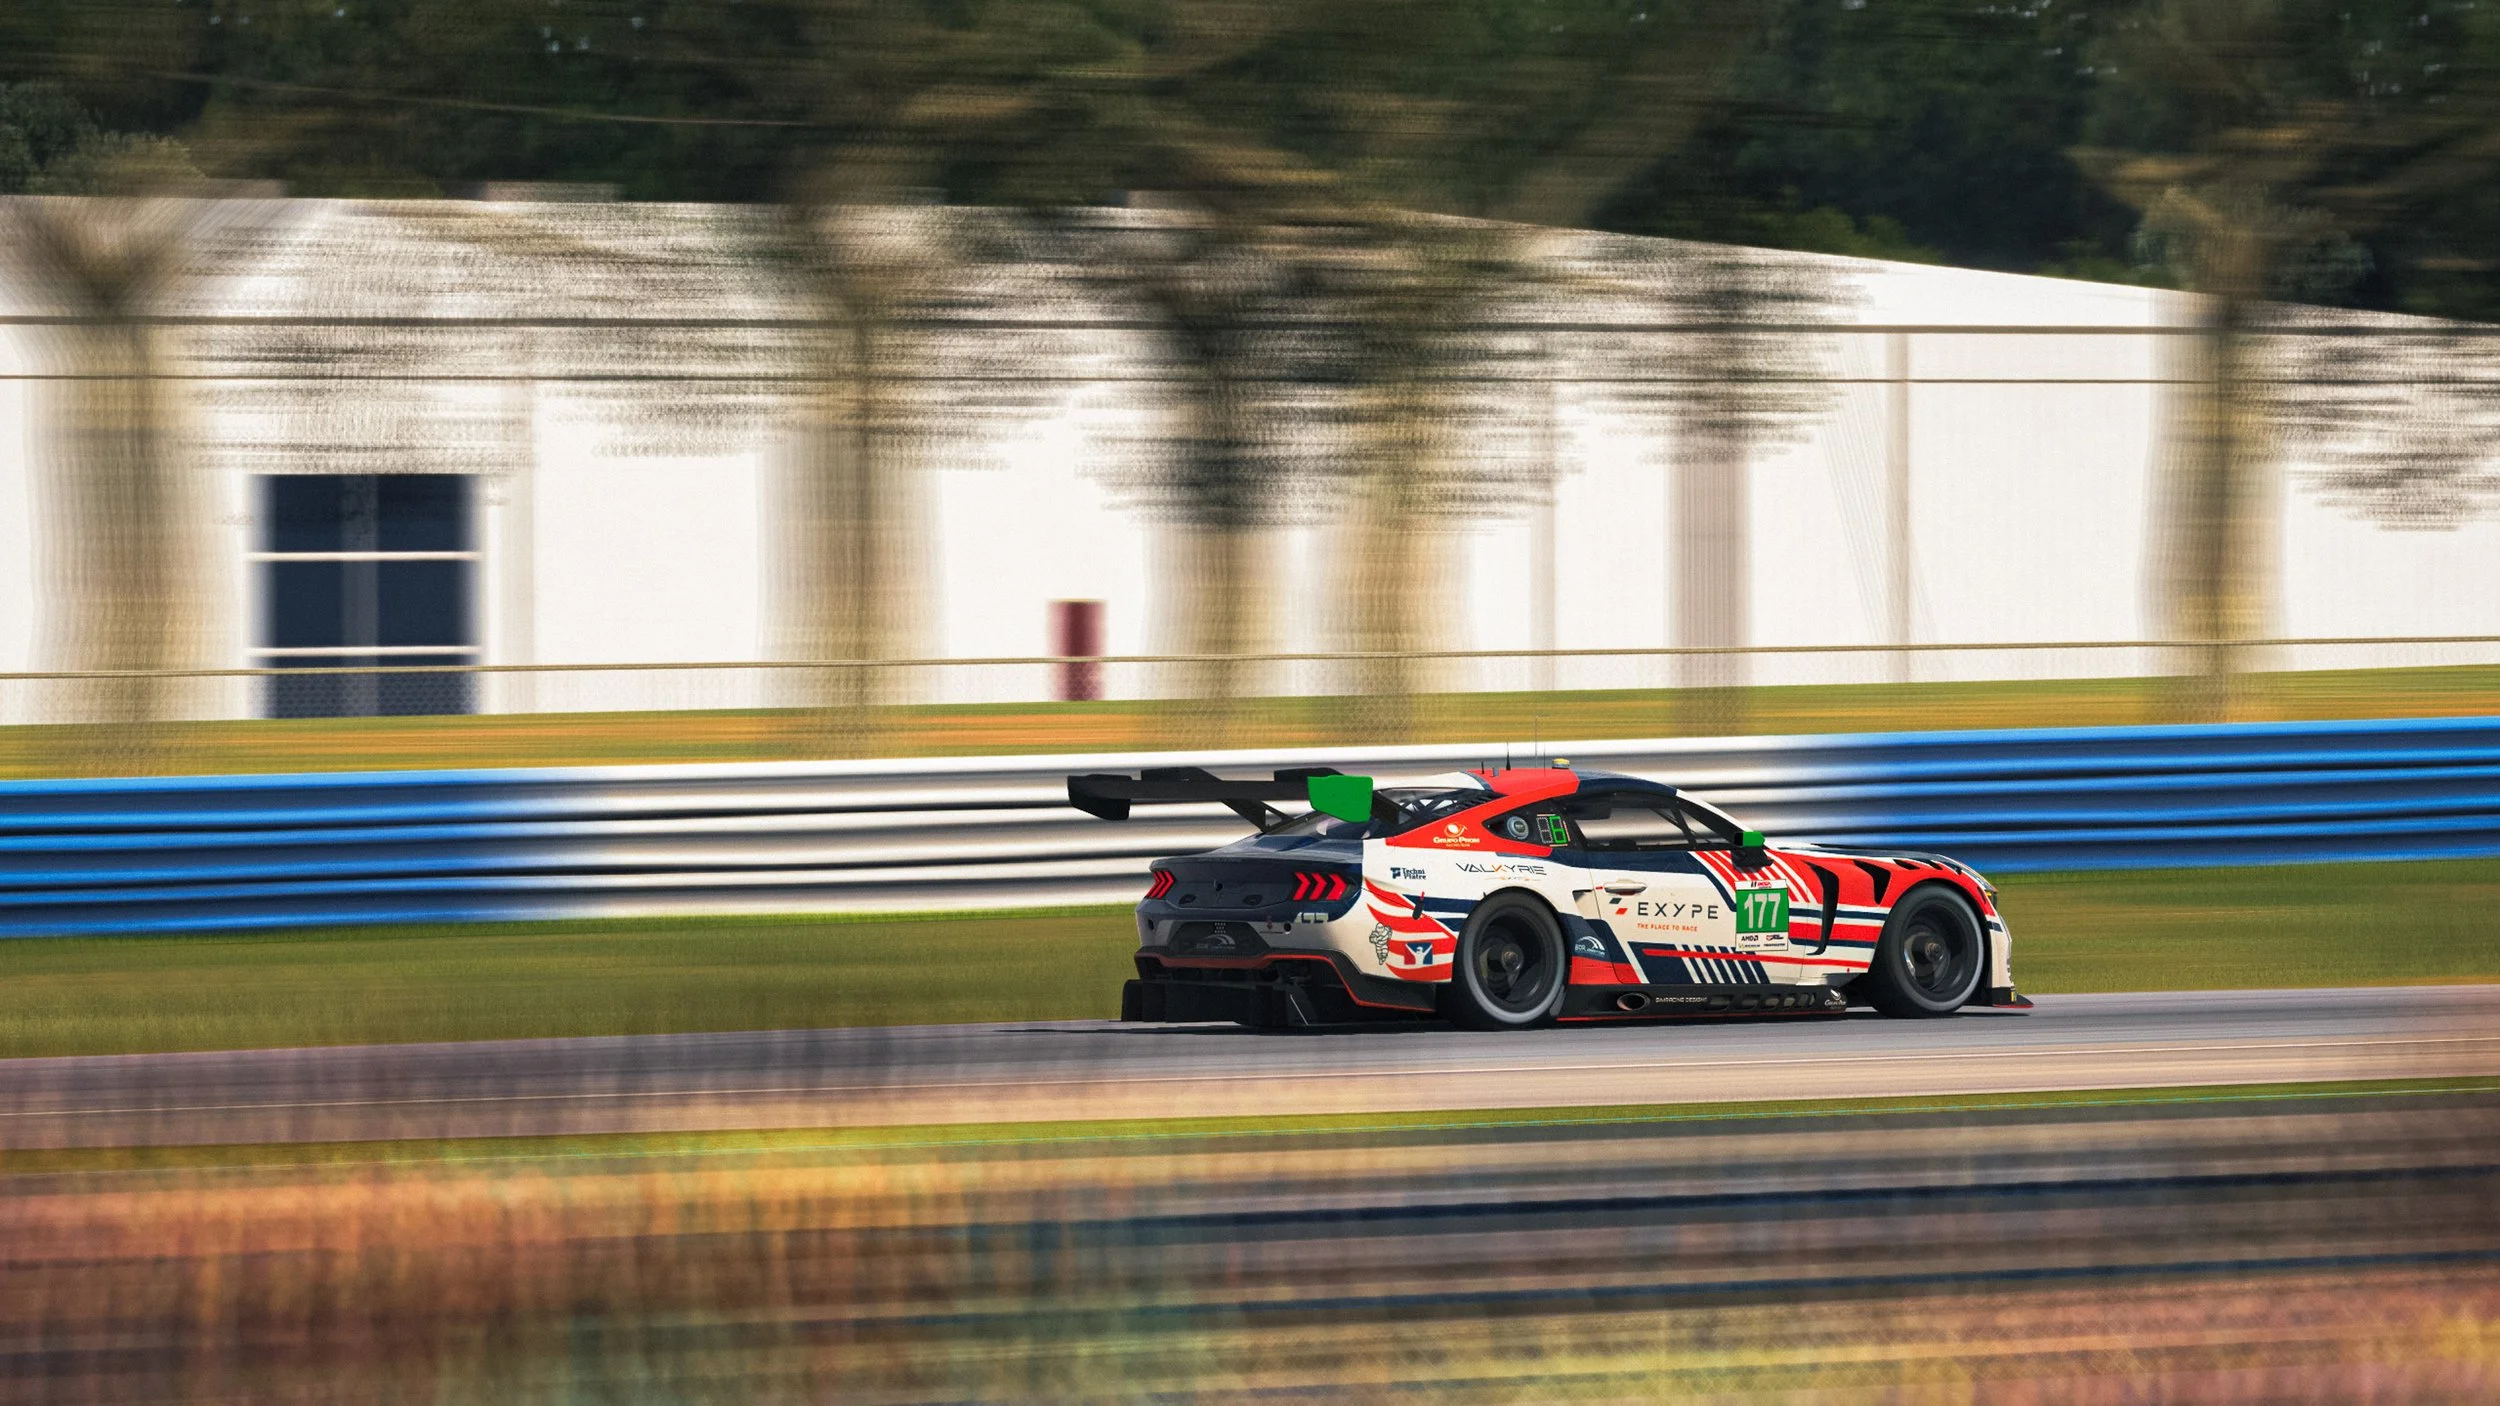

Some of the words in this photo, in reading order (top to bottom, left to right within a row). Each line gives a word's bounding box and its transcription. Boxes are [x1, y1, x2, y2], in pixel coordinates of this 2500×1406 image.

[1549, 816, 1567, 843] 6
[1402, 867, 1425, 875] Techni
[1455, 862, 1547, 875] VALKYRIE
[1637, 902, 1719, 919] EXYPE
[1744, 893, 1781, 929] 177
